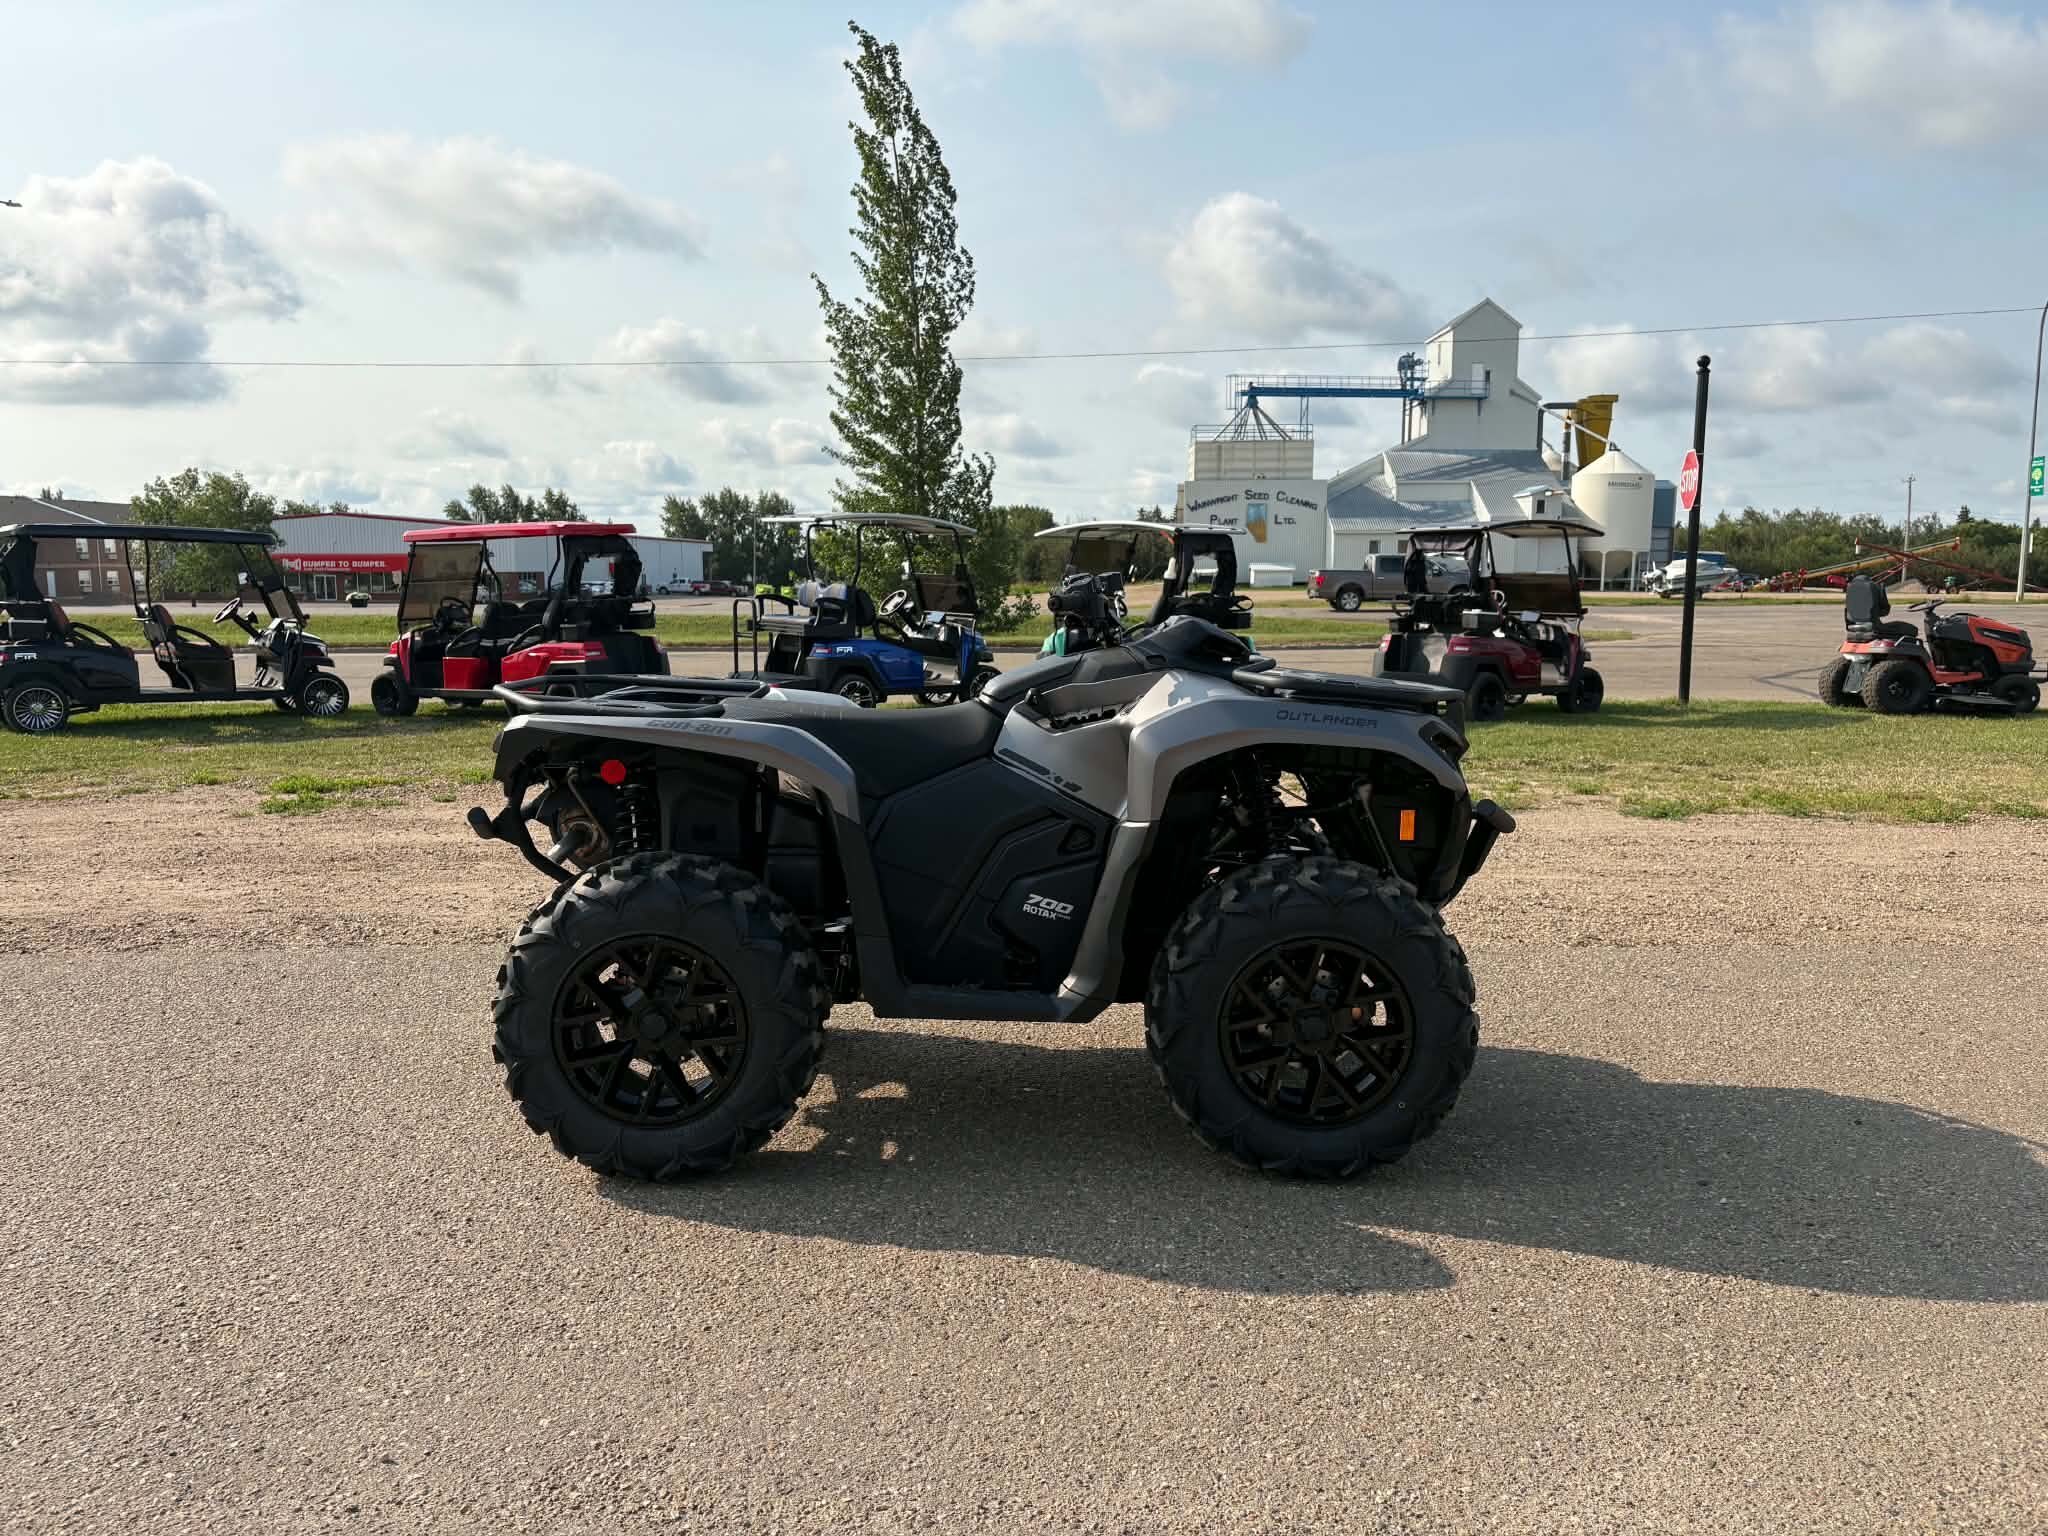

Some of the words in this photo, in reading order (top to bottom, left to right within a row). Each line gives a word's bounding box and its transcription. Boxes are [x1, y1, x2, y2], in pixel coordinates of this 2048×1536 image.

[1681, 469, 1697, 493] STOP
[1244, 489, 1270, 501] SEED
[1210, 514, 1238, 525] PLANT
[339, 560, 350, 568] TO
[1276, 709, 1378, 729] OUTLANDER
[1023, 903, 1057, 920] ROTAX
[1025, 893, 1074, 915] 700
